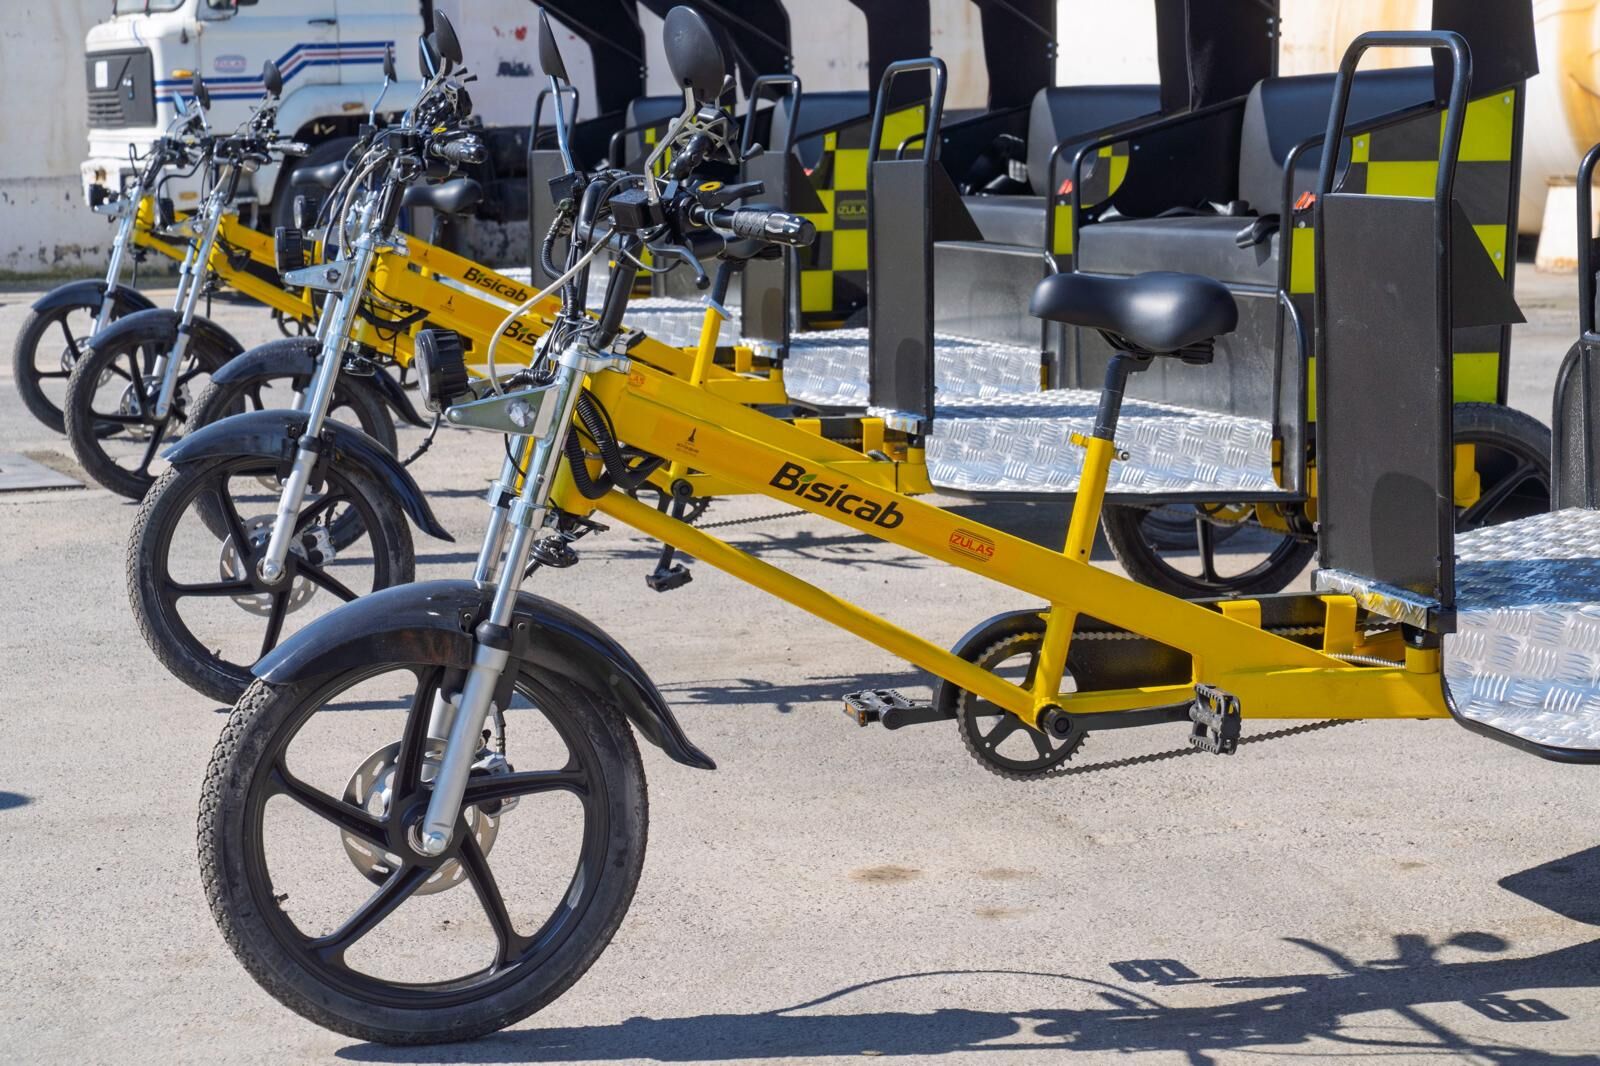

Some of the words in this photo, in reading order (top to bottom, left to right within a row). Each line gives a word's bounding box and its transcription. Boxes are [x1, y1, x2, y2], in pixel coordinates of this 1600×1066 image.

[463, 267, 528, 302] Bisicab
[769, 461, 904, 529] Bisicab
[950, 532, 994, 557] IZULAS
